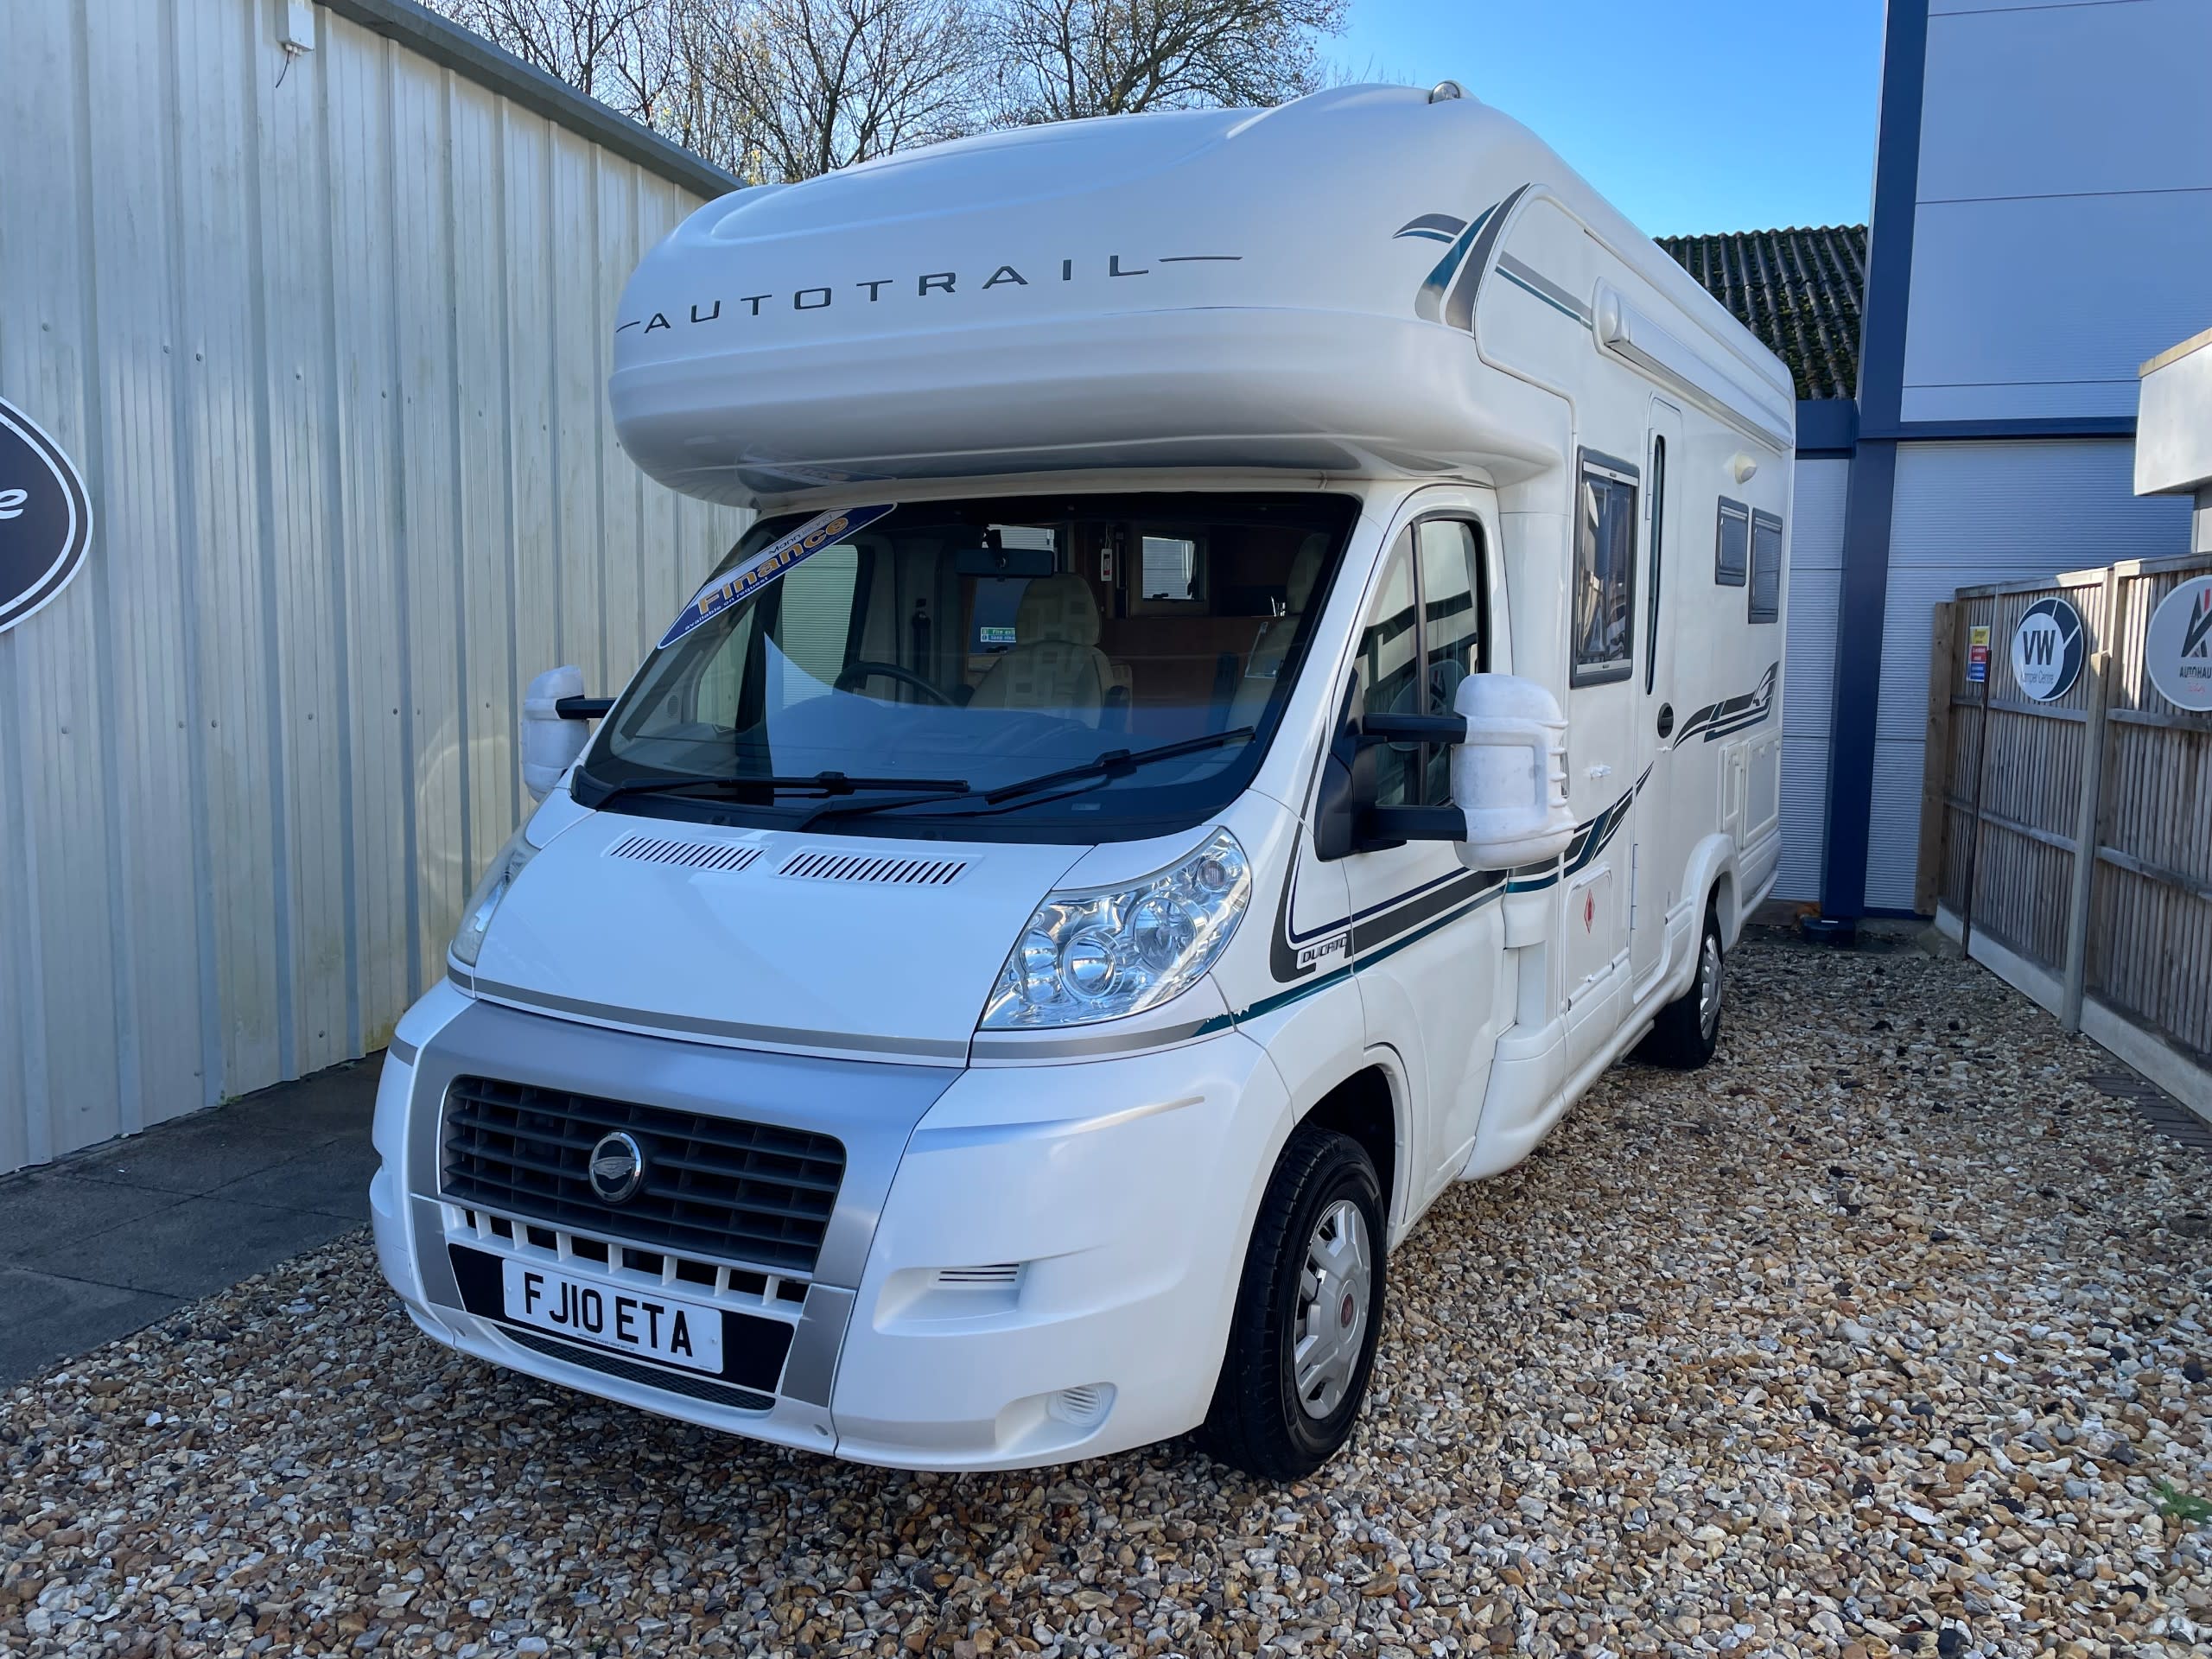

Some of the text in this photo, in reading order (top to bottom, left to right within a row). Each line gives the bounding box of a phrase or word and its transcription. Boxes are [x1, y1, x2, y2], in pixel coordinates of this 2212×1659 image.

[643, 254, 1150, 334] AUTOTRAIL
[698, 517, 849, 615] Finance
[768, 534, 802, 555] Mann
[684, 575, 769, 631] available on request
[2023, 629, 2056, 665] VW
[1301, 937, 1348, 964] DUCATO
[524, 1271, 694, 1357] FJ10 ETA
